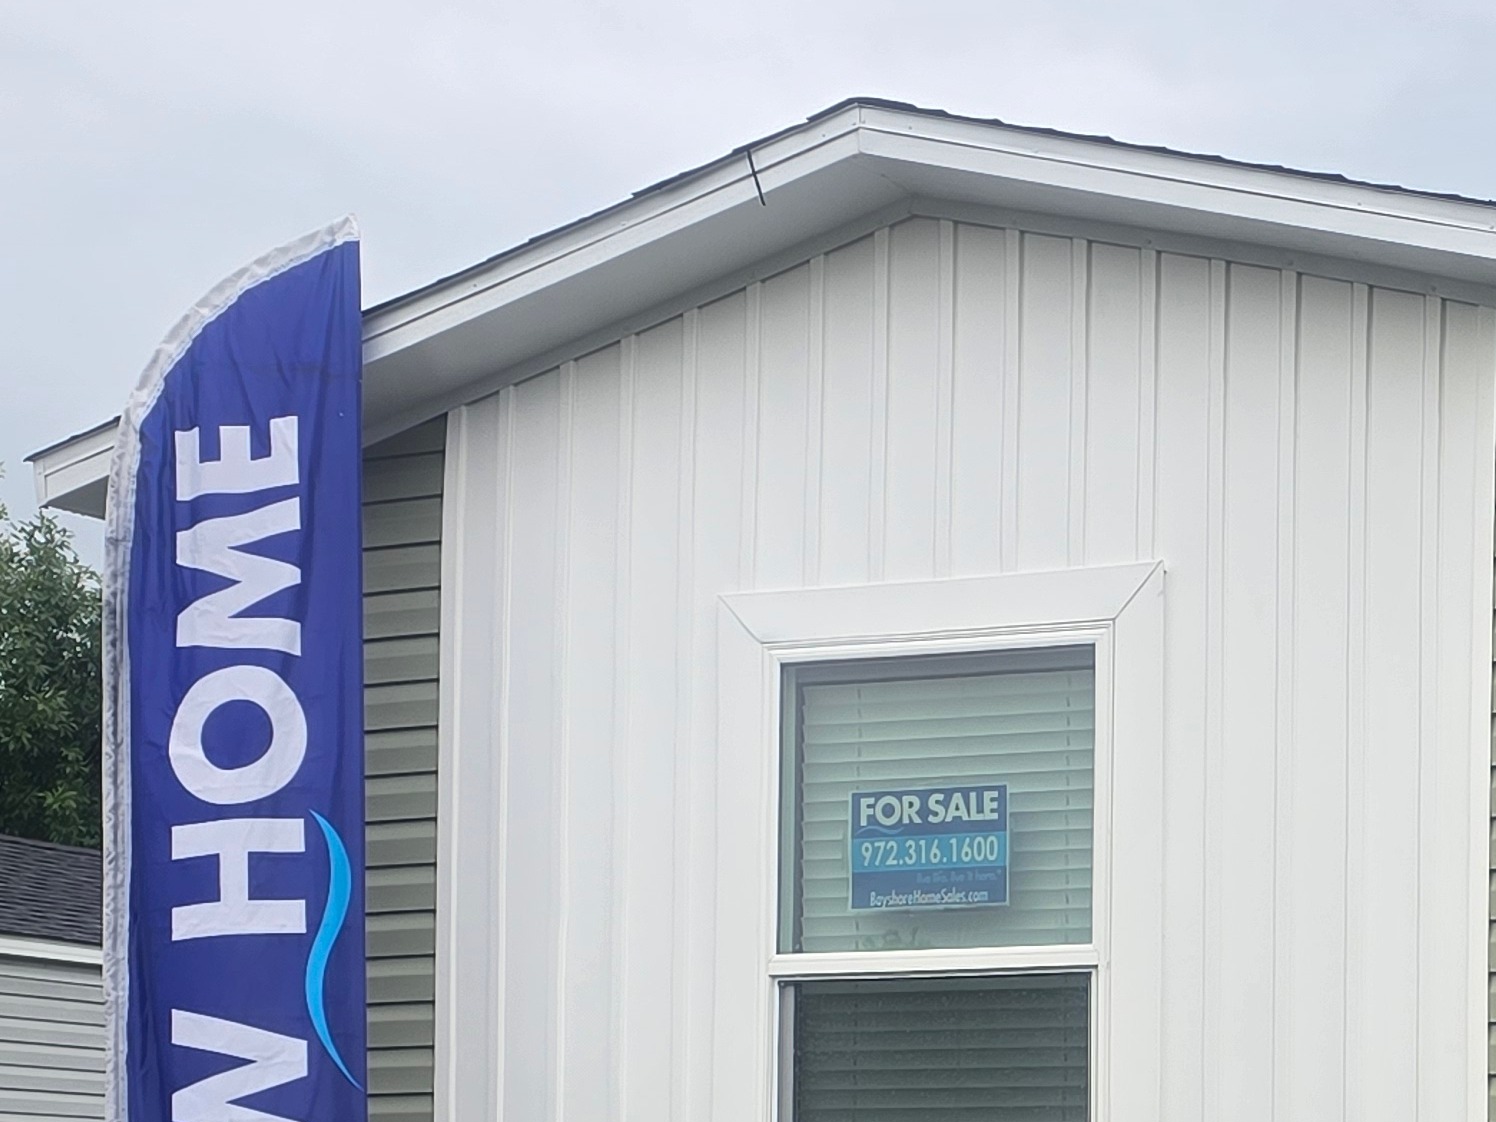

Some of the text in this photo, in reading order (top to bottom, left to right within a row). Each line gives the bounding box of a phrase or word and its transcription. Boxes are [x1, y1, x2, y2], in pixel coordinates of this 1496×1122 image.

[169, 416, 307, 941] HOME
[860, 791, 999, 827] FOR SALE
[861, 836, 998, 867] 972.316.1600
[870, 887, 988, 908] BayshoreHomeSales.com
